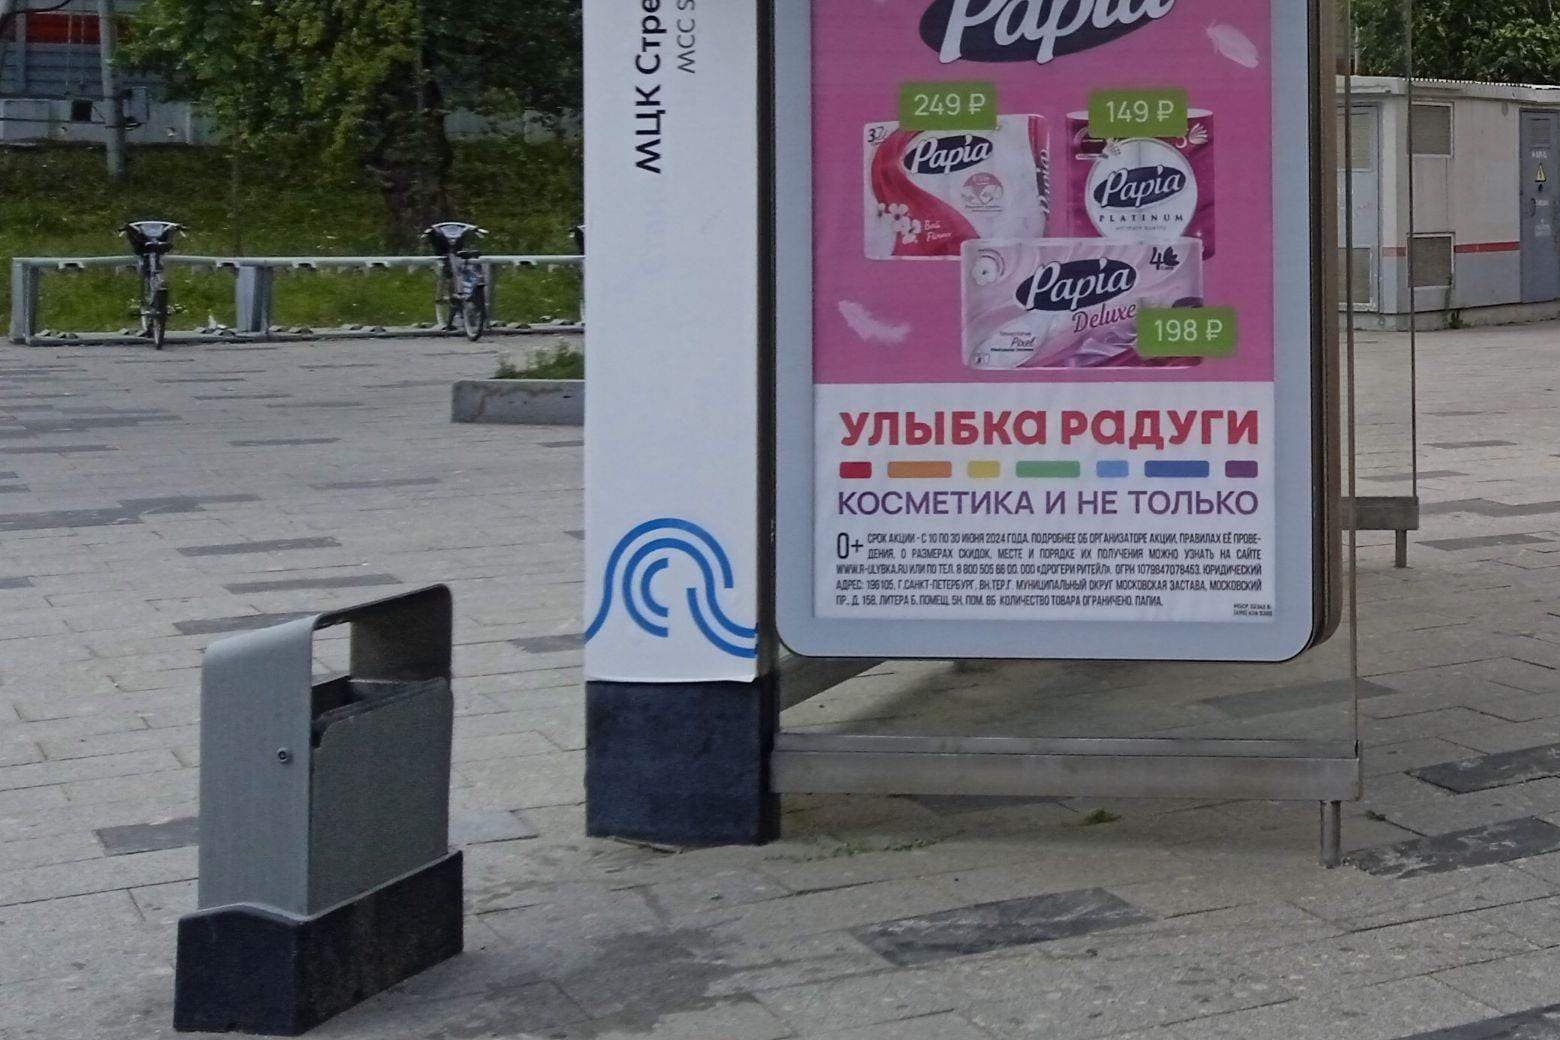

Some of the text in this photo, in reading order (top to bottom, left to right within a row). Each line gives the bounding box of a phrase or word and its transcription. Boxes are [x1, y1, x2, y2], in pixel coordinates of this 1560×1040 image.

[676, 17, 695, 74] MCC
[913, 93, 961, 116] 249
[1106, 100, 1149, 123] 149
[635, 84, 666, 174] МЦК
[910, 134, 993, 174] Papia
[1101, 164, 1182, 208] Papia
[1099, 214, 1184, 222] PLATINUM
[1025, 257, 1131, 310] Papia
[1072, 302, 1137, 333] Deluxe
[1154, 319, 1198, 342] 198
[838, 490, 1259, 515] КОСМЕТИКА И НЕ ТОЛЬКО
[837, 532, 864, 559] 0+
[867, 533, 887, 544] СРОК
[888, 533, 915, 544] АКЦИИ
[986, 533, 1006, 544] 2024
[1031, 533, 1076, 544] ПОДРОБНЕЕ
[1077, 533, 1088, 544] ОБ
[1089, 533, 1147, 544] ОРГАНИЗАТОРЕ
[1180, 533, 1221, 544] ПРАВИЛАХ
[912, 548, 953, 559] РАЗМЕРАХ
[997, 548, 1023, 559] МЕСТЕ
[1039, 548, 1075, 559] ПОРЯДКЕ
[1081, 548, 1092, 559] ИХ
[1097, 548, 1143, 559] ПОЛУЧЕНИЯ
[1149, 548, 1179, 559] МОЖНО
[1184, 548, 1214, 559] УЗНАТЬ
[1220, 548, 1231, 559] НА
[1236, 546, 1262, 559] САЙТЕ
[963, 564, 978, 575] 800
[1115, 564, 1135, 575] ОГРН
[1203, 563, 1262, 575] ЮРИДИЧЕСКИЙ
[1016, 578, 1087, 590] МУНИЦИПАЛЬНЫЙ
[1089, 579, 1113, 590] ОКРУГ
[1116, 579, 1168, 590] МОСКОВСКАЯ
[1209, 578, 1262, 591] МОСКОВСКИЙ
[879, 595, 909, 606] ЛИТЕРА
[999, 595, 1050, 606] КОЛИЧЕСТВО
[1051, 595, 1081, 606] ТОВАРА
